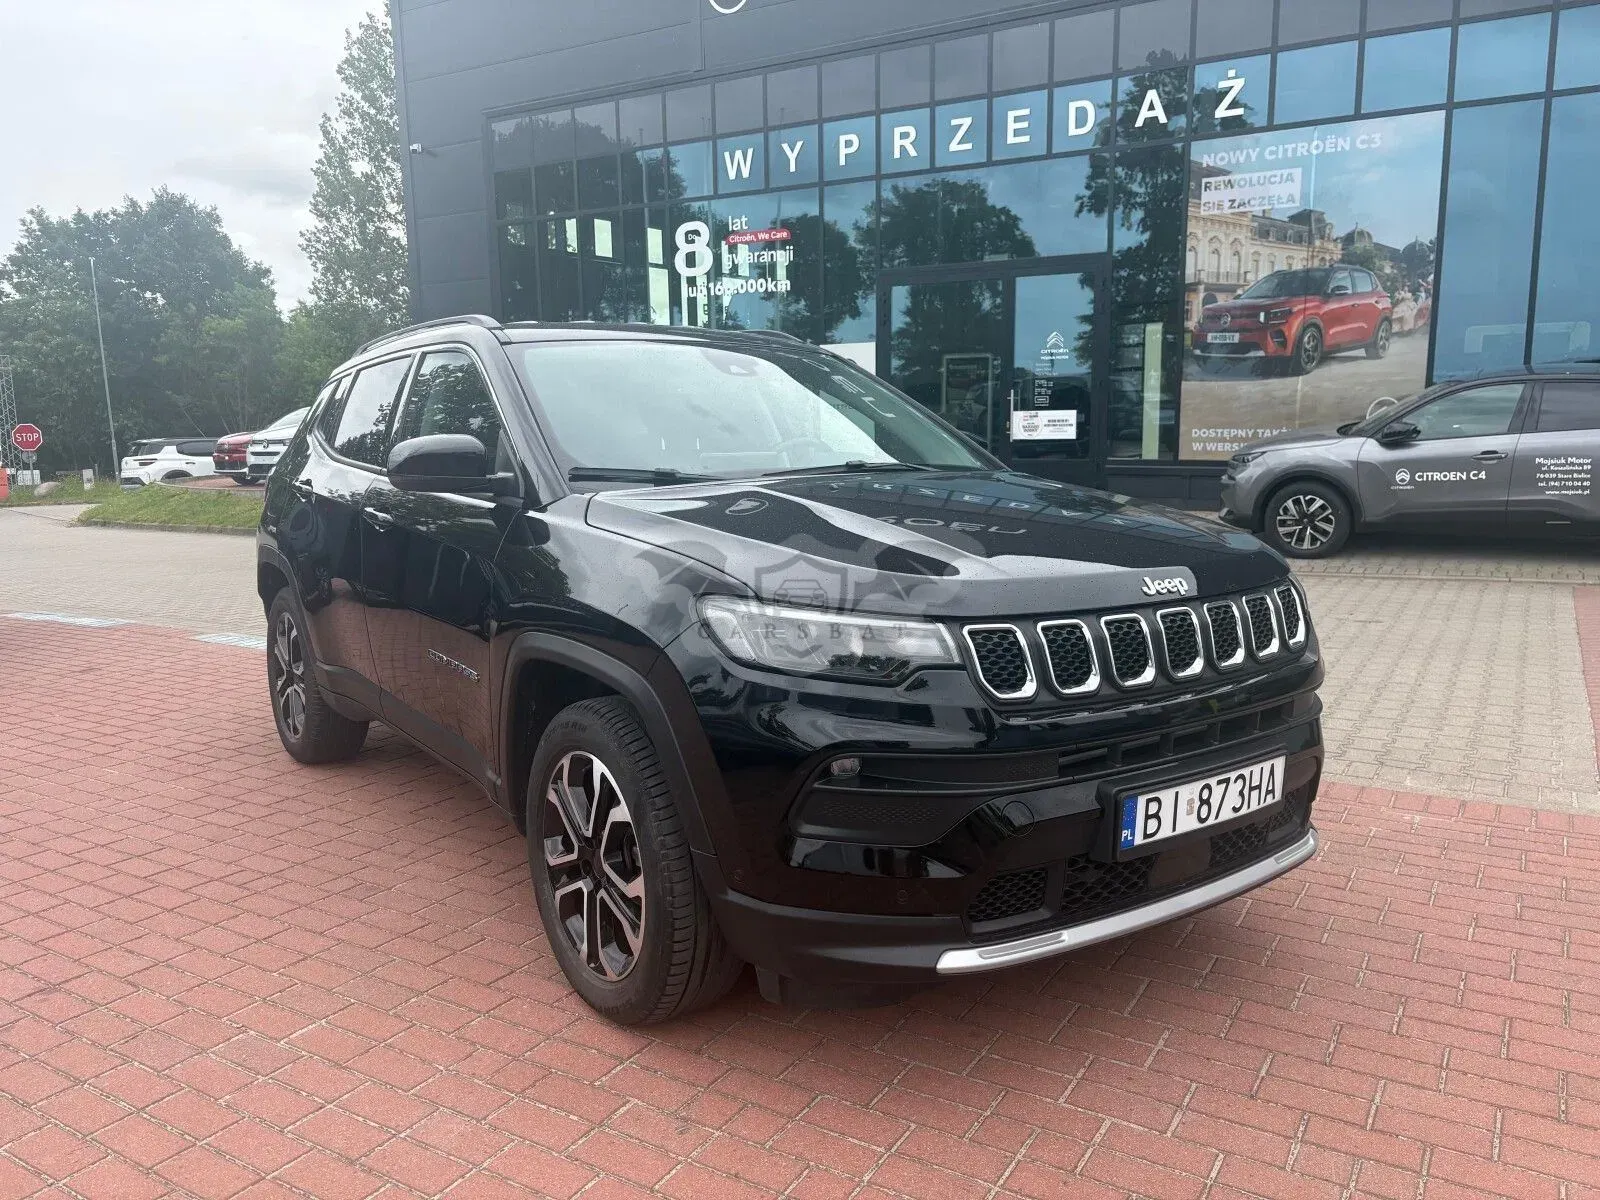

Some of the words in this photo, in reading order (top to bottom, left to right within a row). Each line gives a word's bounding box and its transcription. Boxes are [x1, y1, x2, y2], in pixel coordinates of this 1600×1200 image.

[724, 69, 1246, 180] WYPRZEDAŻ
[1202, 148, 1260, 167] NOWY
[1264, 135, 1350, 160] CITROËN
[1356, 133, 1383, 149] C3
[1204, 173, 1294, 192] REWOLUCJA
[728, 215, 748, 231] lat
[757, 232, 769, 240] We
[771, 231, 788, 239] Care
[674, 220, 714, 276] 8
[15, 433, 39, 442] STOP
[1192, 428, 1254, 440] DOSTĘPNY
[1192, 443, 1204, 452] W
[1535, 457, 1566, 465] Mojsiuk
[1415, 471, 1467, 481] CITROEN
[1470, 470, 1487, 480] C4
[1141, 576, 1189, 596] Jeep
[1142, 790, 1179, 840] BI
[1196, 763, 1276, 824] 873HA
[1121, 829, 1133, 842] PL
